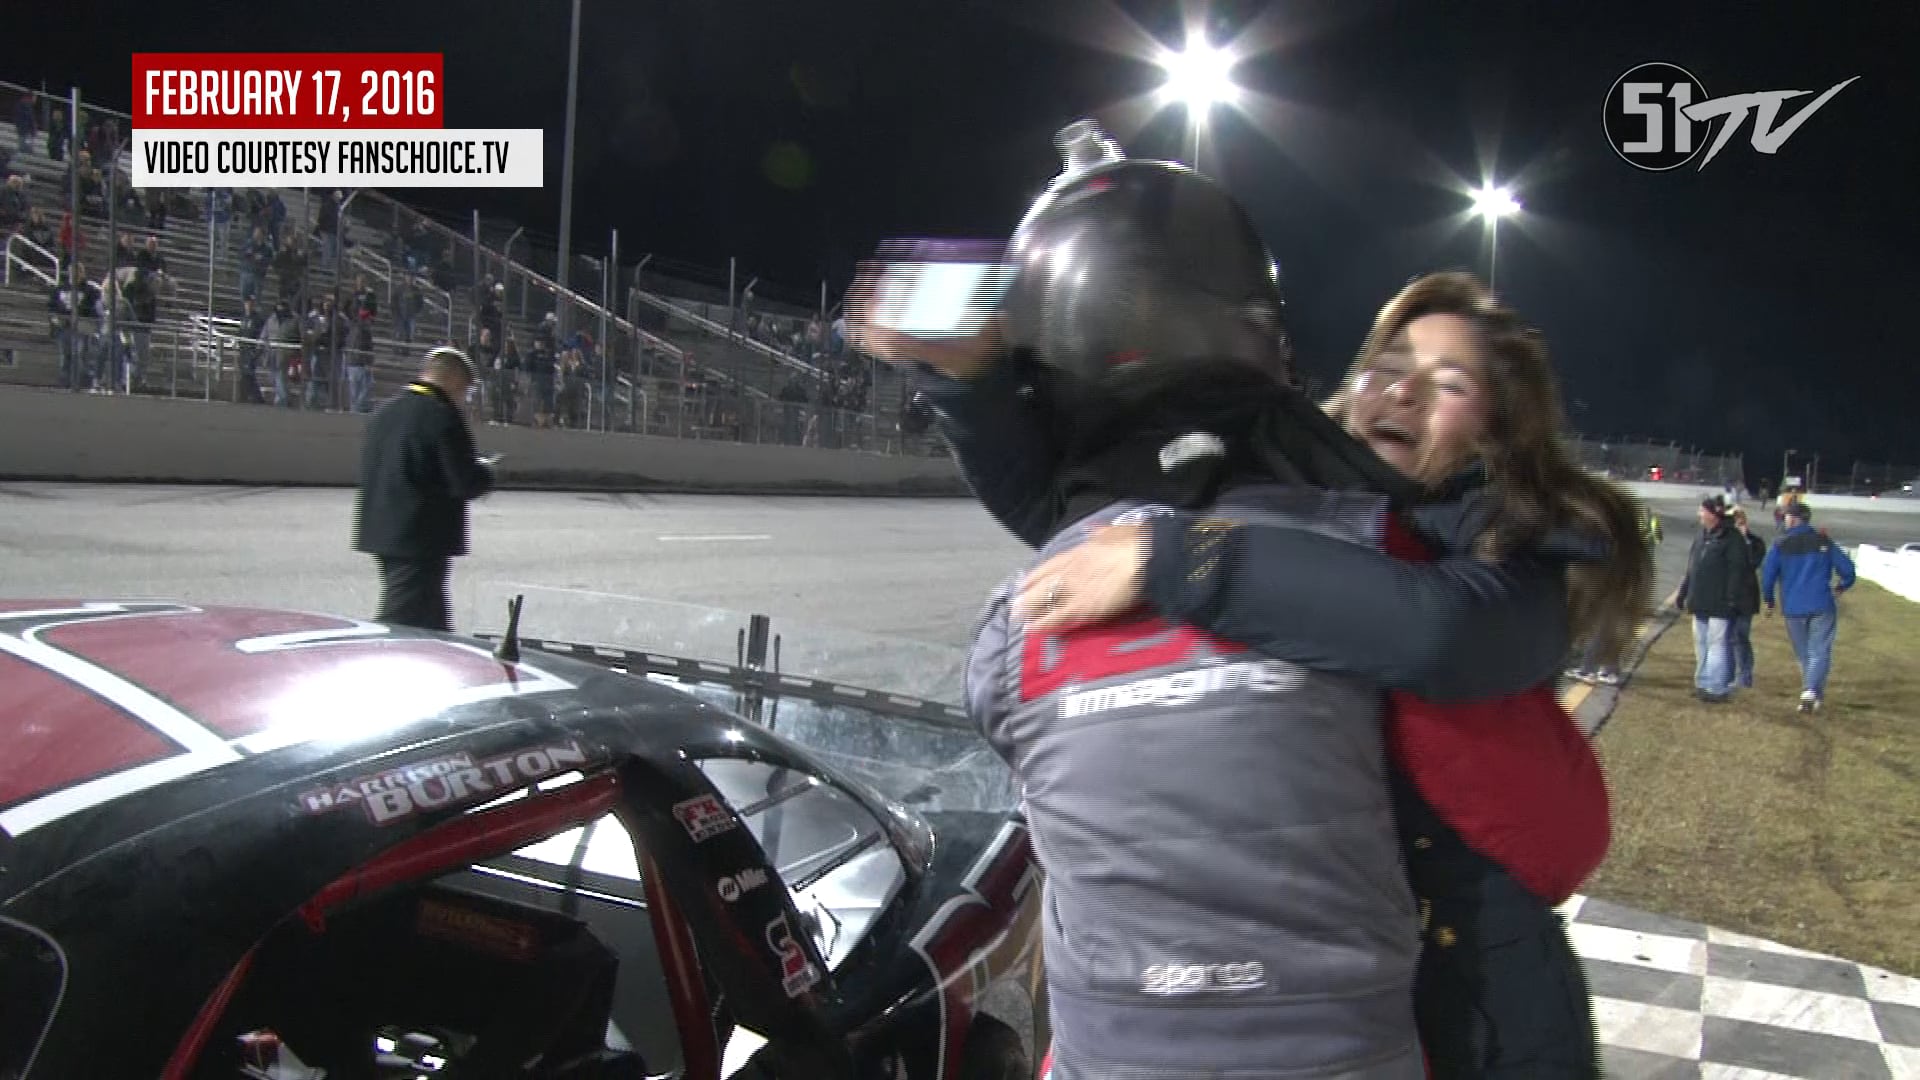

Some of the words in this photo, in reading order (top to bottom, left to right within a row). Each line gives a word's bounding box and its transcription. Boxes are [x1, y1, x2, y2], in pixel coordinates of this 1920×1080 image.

[1056, 656, 1308, 719] imaging
[305, 751, 474, 811] HARRISON
[360, 740, 587, 823] BURTON
[1145, 960, 1266, 995] sparco
